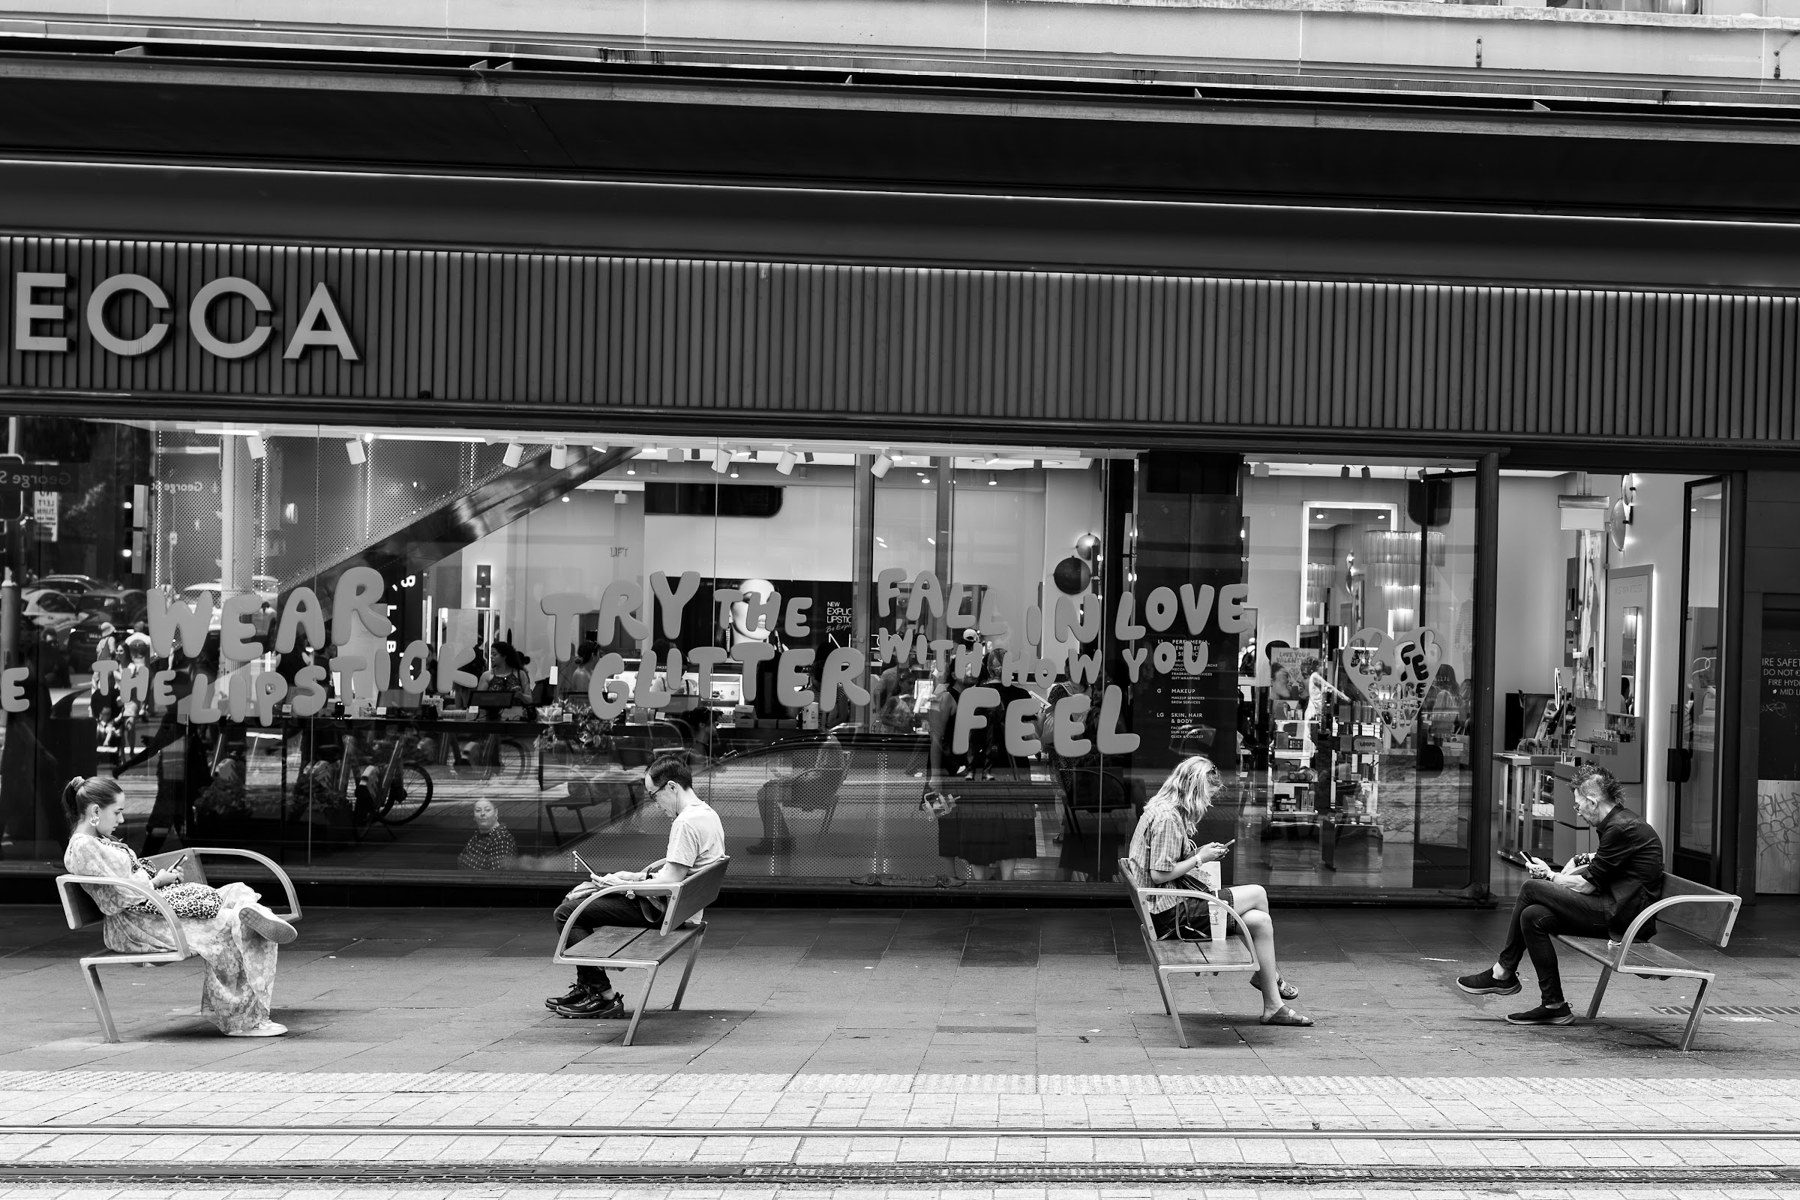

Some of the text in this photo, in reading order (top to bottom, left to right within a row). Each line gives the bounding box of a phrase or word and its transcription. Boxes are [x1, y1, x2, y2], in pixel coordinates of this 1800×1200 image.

[15, 271, 360, 361] ECCA
[610, 546, 629, 558] LIFT
[147, 567, 392, 662] WEAR
[540, 571, 813, 662] TRY THE
[877, 567, 1250, 646] FALL IN LOVE
[1, 667, 29, 713] E
[92, 659, 176, 705] THE
[186, 639, 479, 727] LIPSTICK
[588, 642, 871, 720] GLITTER
[879, 628, 982, 678] WITH
[1001, 648, 1102, 688] HOW
[1122, 641, 1209, 684] YOU
[1763, 668, 1776, 676] DO
[1777, 669, 1794, 677] NOT
[1768, 678, 1800, 687] FIRE HYD
[1779, 688, 1794, 696] MID
[953, 685, 1140, 758] FEEL
